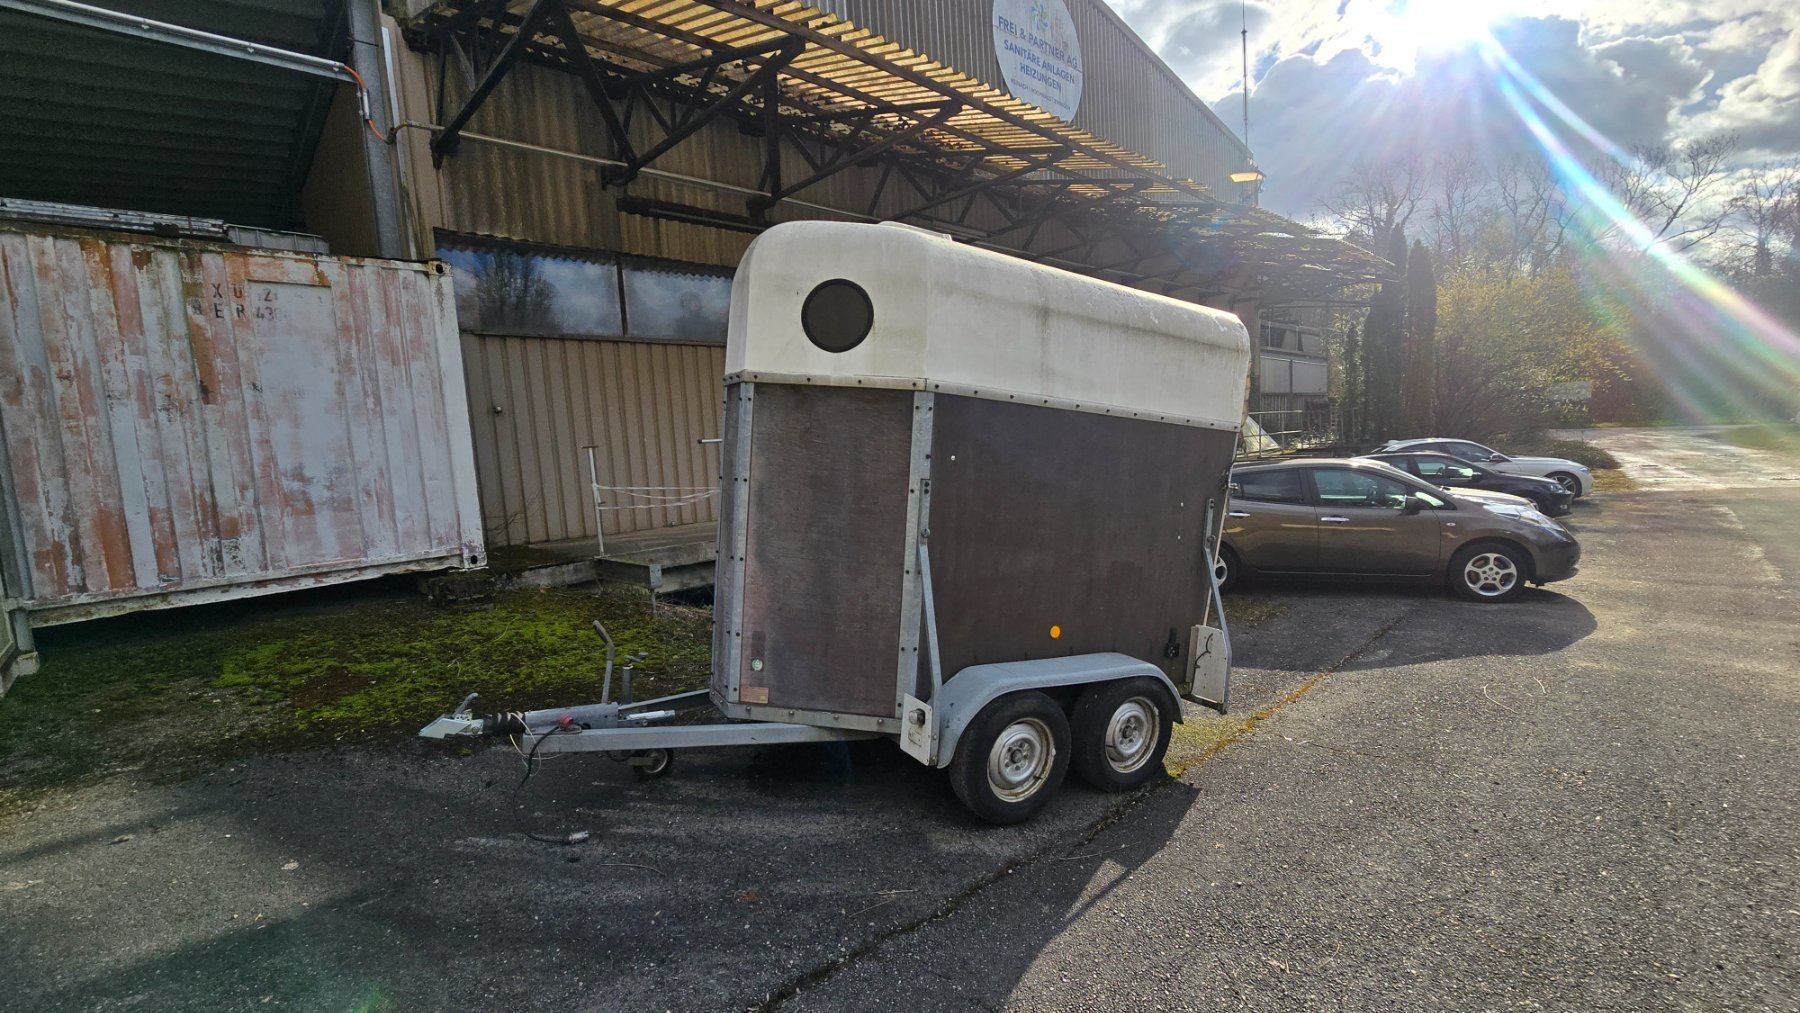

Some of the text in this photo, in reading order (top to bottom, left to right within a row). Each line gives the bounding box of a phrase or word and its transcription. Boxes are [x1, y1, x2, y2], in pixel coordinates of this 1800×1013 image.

[998, 15, 1078, 70] FREI & PARTNER AG
[1004, 39, 1075, 85] SANITÄRE ANLAGEN
[1019, 62, 1062, 93] HEIZUNGEN
